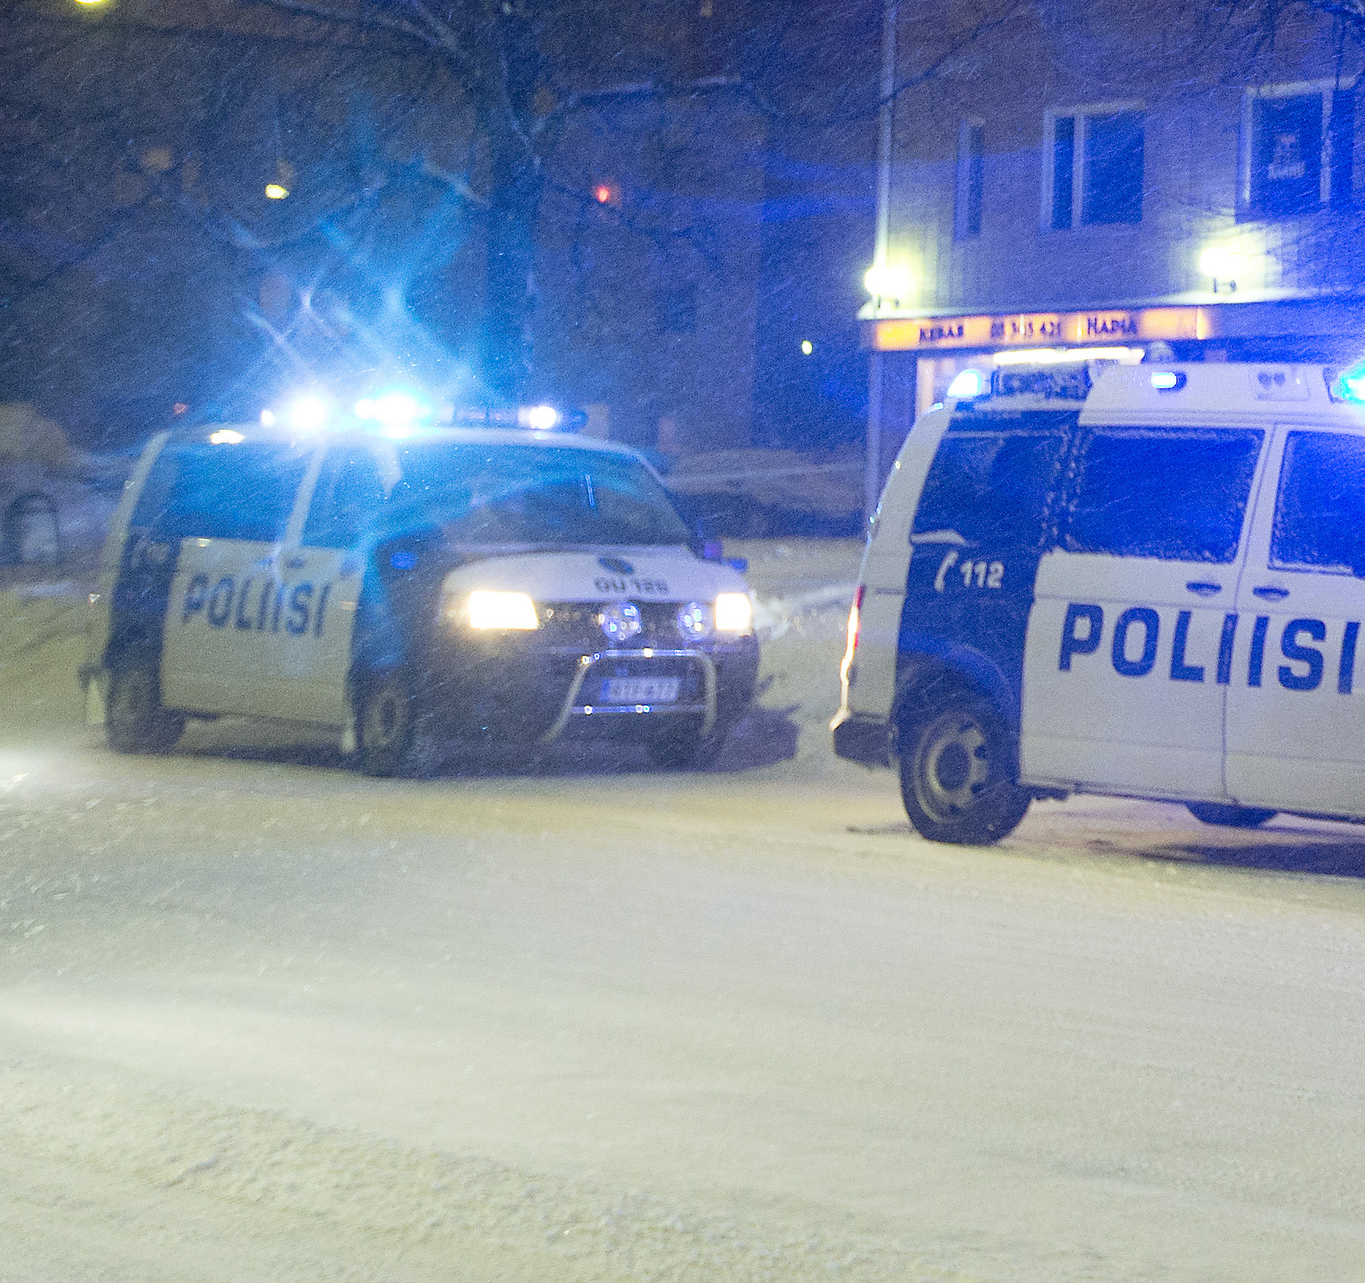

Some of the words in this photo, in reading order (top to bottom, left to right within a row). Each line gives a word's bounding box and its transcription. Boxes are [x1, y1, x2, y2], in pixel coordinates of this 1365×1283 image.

[184, 572, 333, 639] POLIISI
[960, 560, 1004, 588] 112
[1059, 604, 1361, 694] POLIISI
